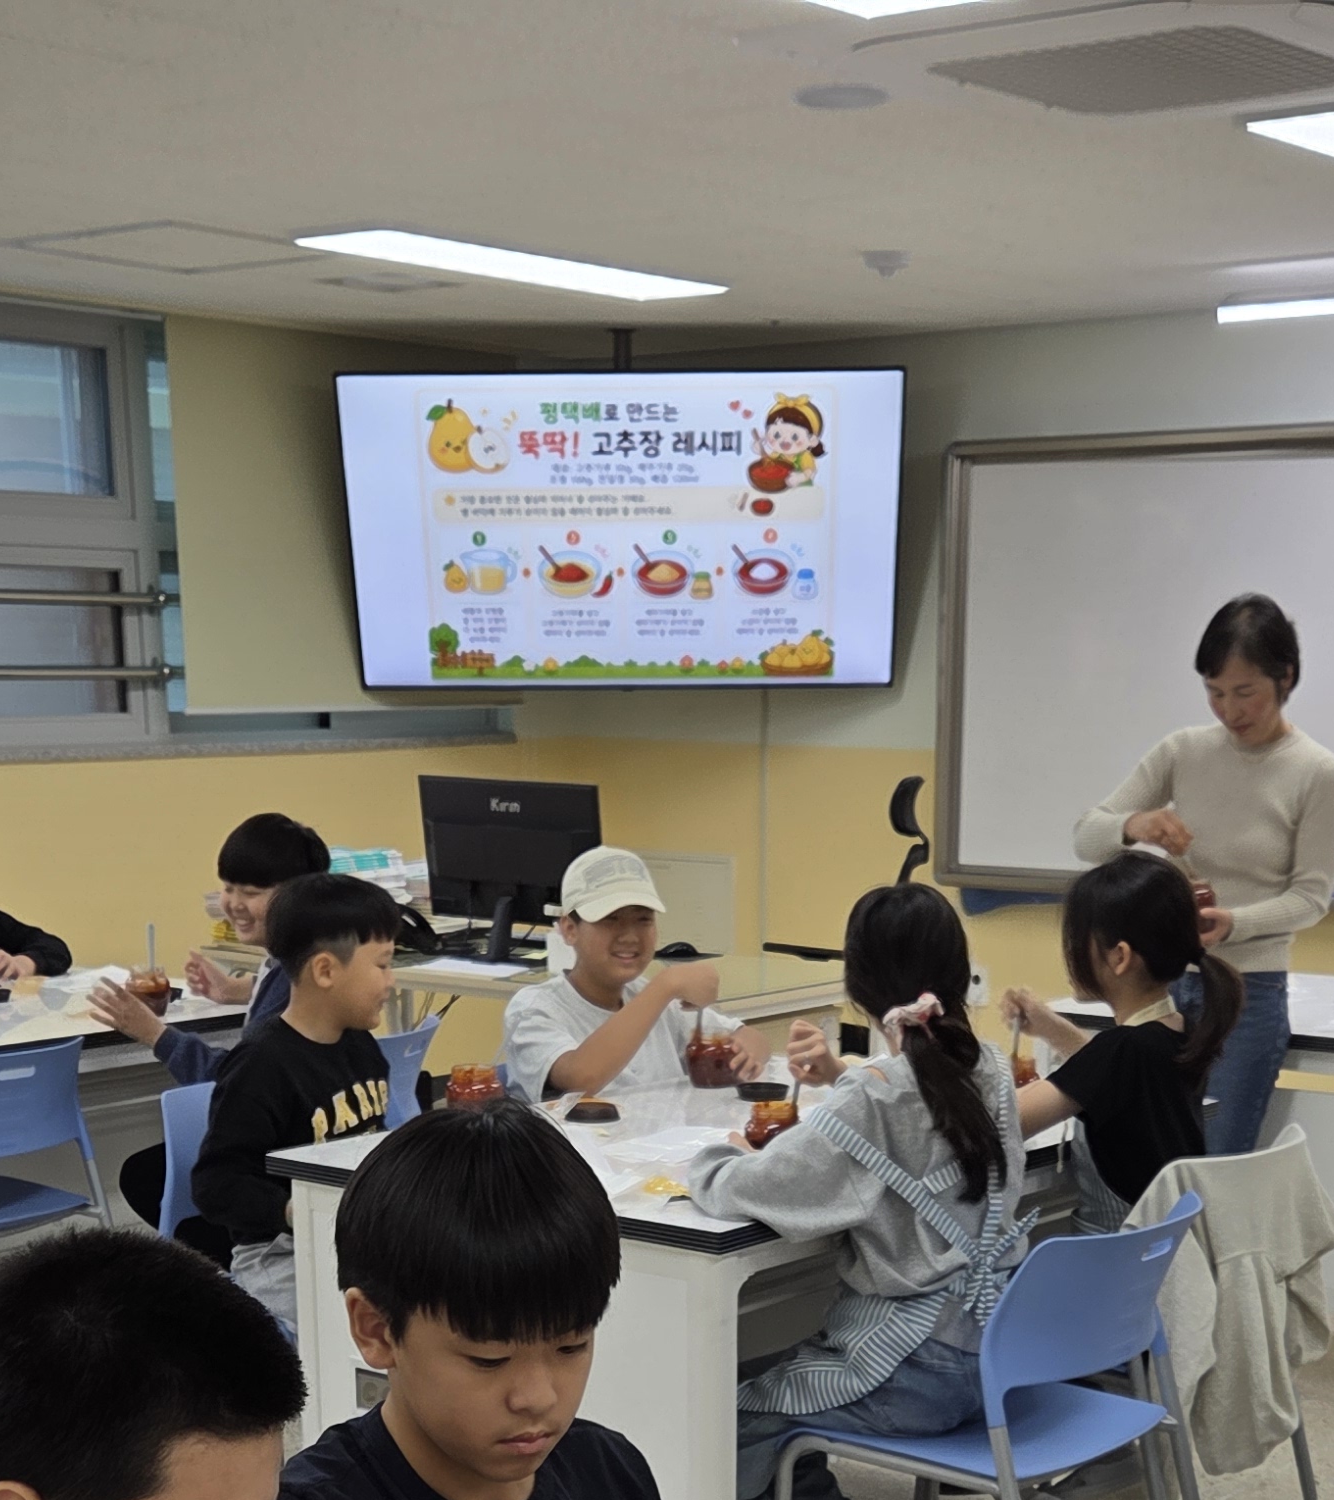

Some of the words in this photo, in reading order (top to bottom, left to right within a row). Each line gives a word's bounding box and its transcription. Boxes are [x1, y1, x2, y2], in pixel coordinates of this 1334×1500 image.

[539, 402, 620, 425] 평택배로
[625, 402, 680, 423] 만드는
[518, 430, 580, 459] 뚝딱!
[591, 430, 664, 458] 고추장
[671, 430, 742, 457] 레시피
